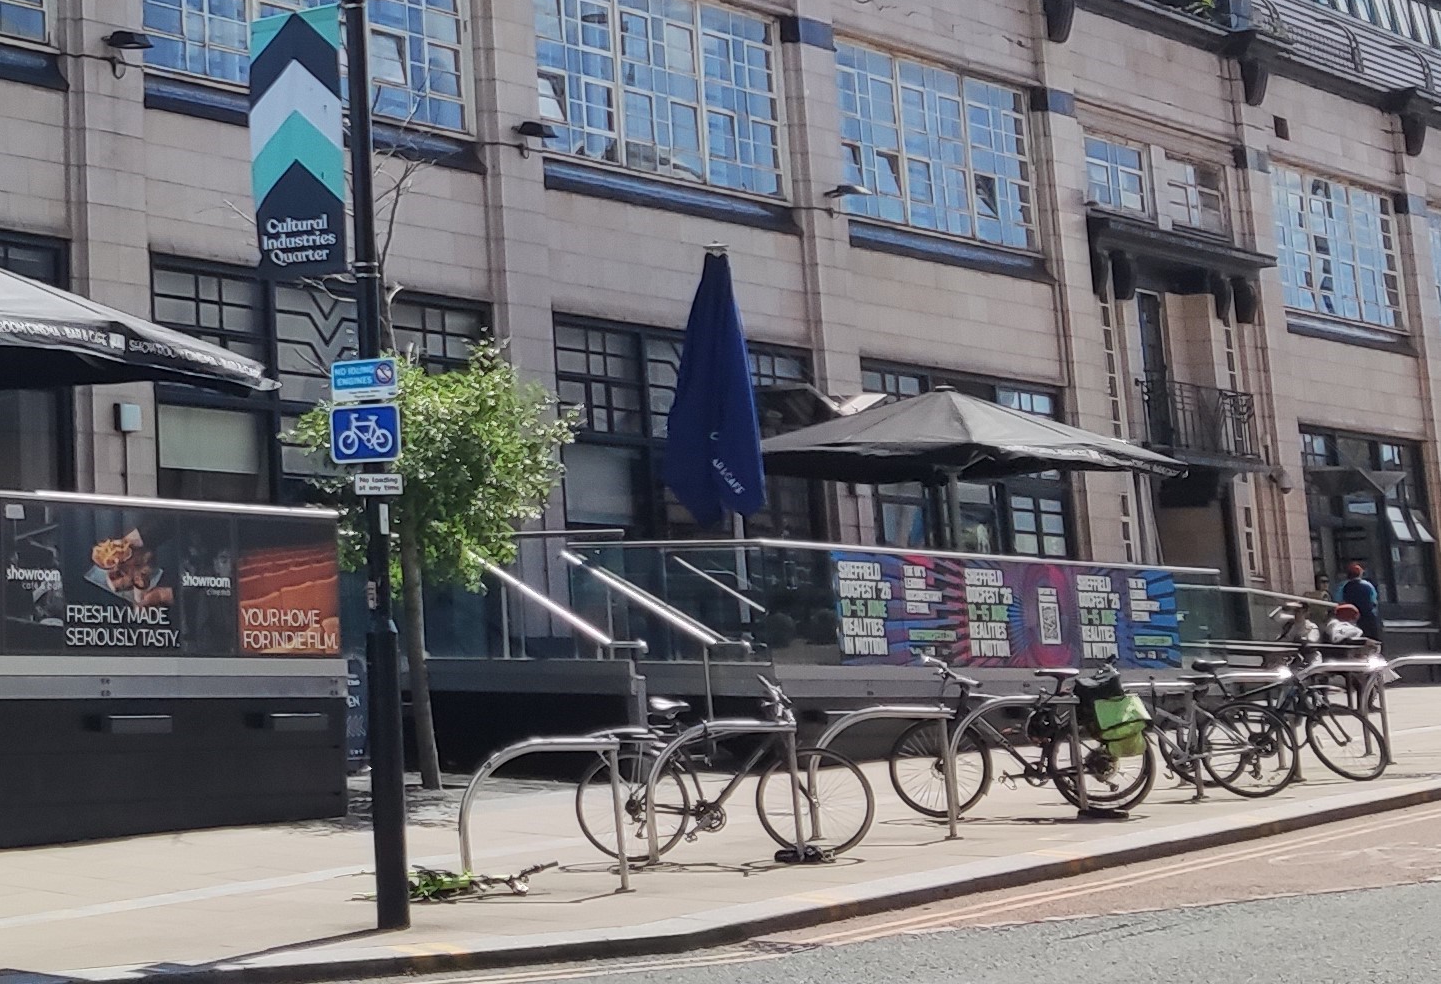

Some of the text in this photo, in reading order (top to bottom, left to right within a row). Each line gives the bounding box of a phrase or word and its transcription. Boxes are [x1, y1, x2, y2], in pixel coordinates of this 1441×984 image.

[266, 213, 329, 234] Cultural
[262, 231, 337, 251] Industries
[270, 249, 330, 267] Quarter
[6, 564, 62, 582] showroom
[182, 571, 231, 588] showroom
[838, 560, 881, 580] SHEFFIELD
[964, 568, 1004, 587] SHEFFIELD
[839, 580, 876, 599] DOCFEST
[1077, 574, 1111, 592] SHEFFIELD
[66, 605, 127, 624] FRESHLY
[241, 608, 321, 628] YOUR HOME
[842, 617, 885, 637] REALITIES
[66, 627, 180, 648] SERIOUSLY TASTY.
[243, 630, 271, 649] FOR
[272, 631, 307, 649] INDIE
